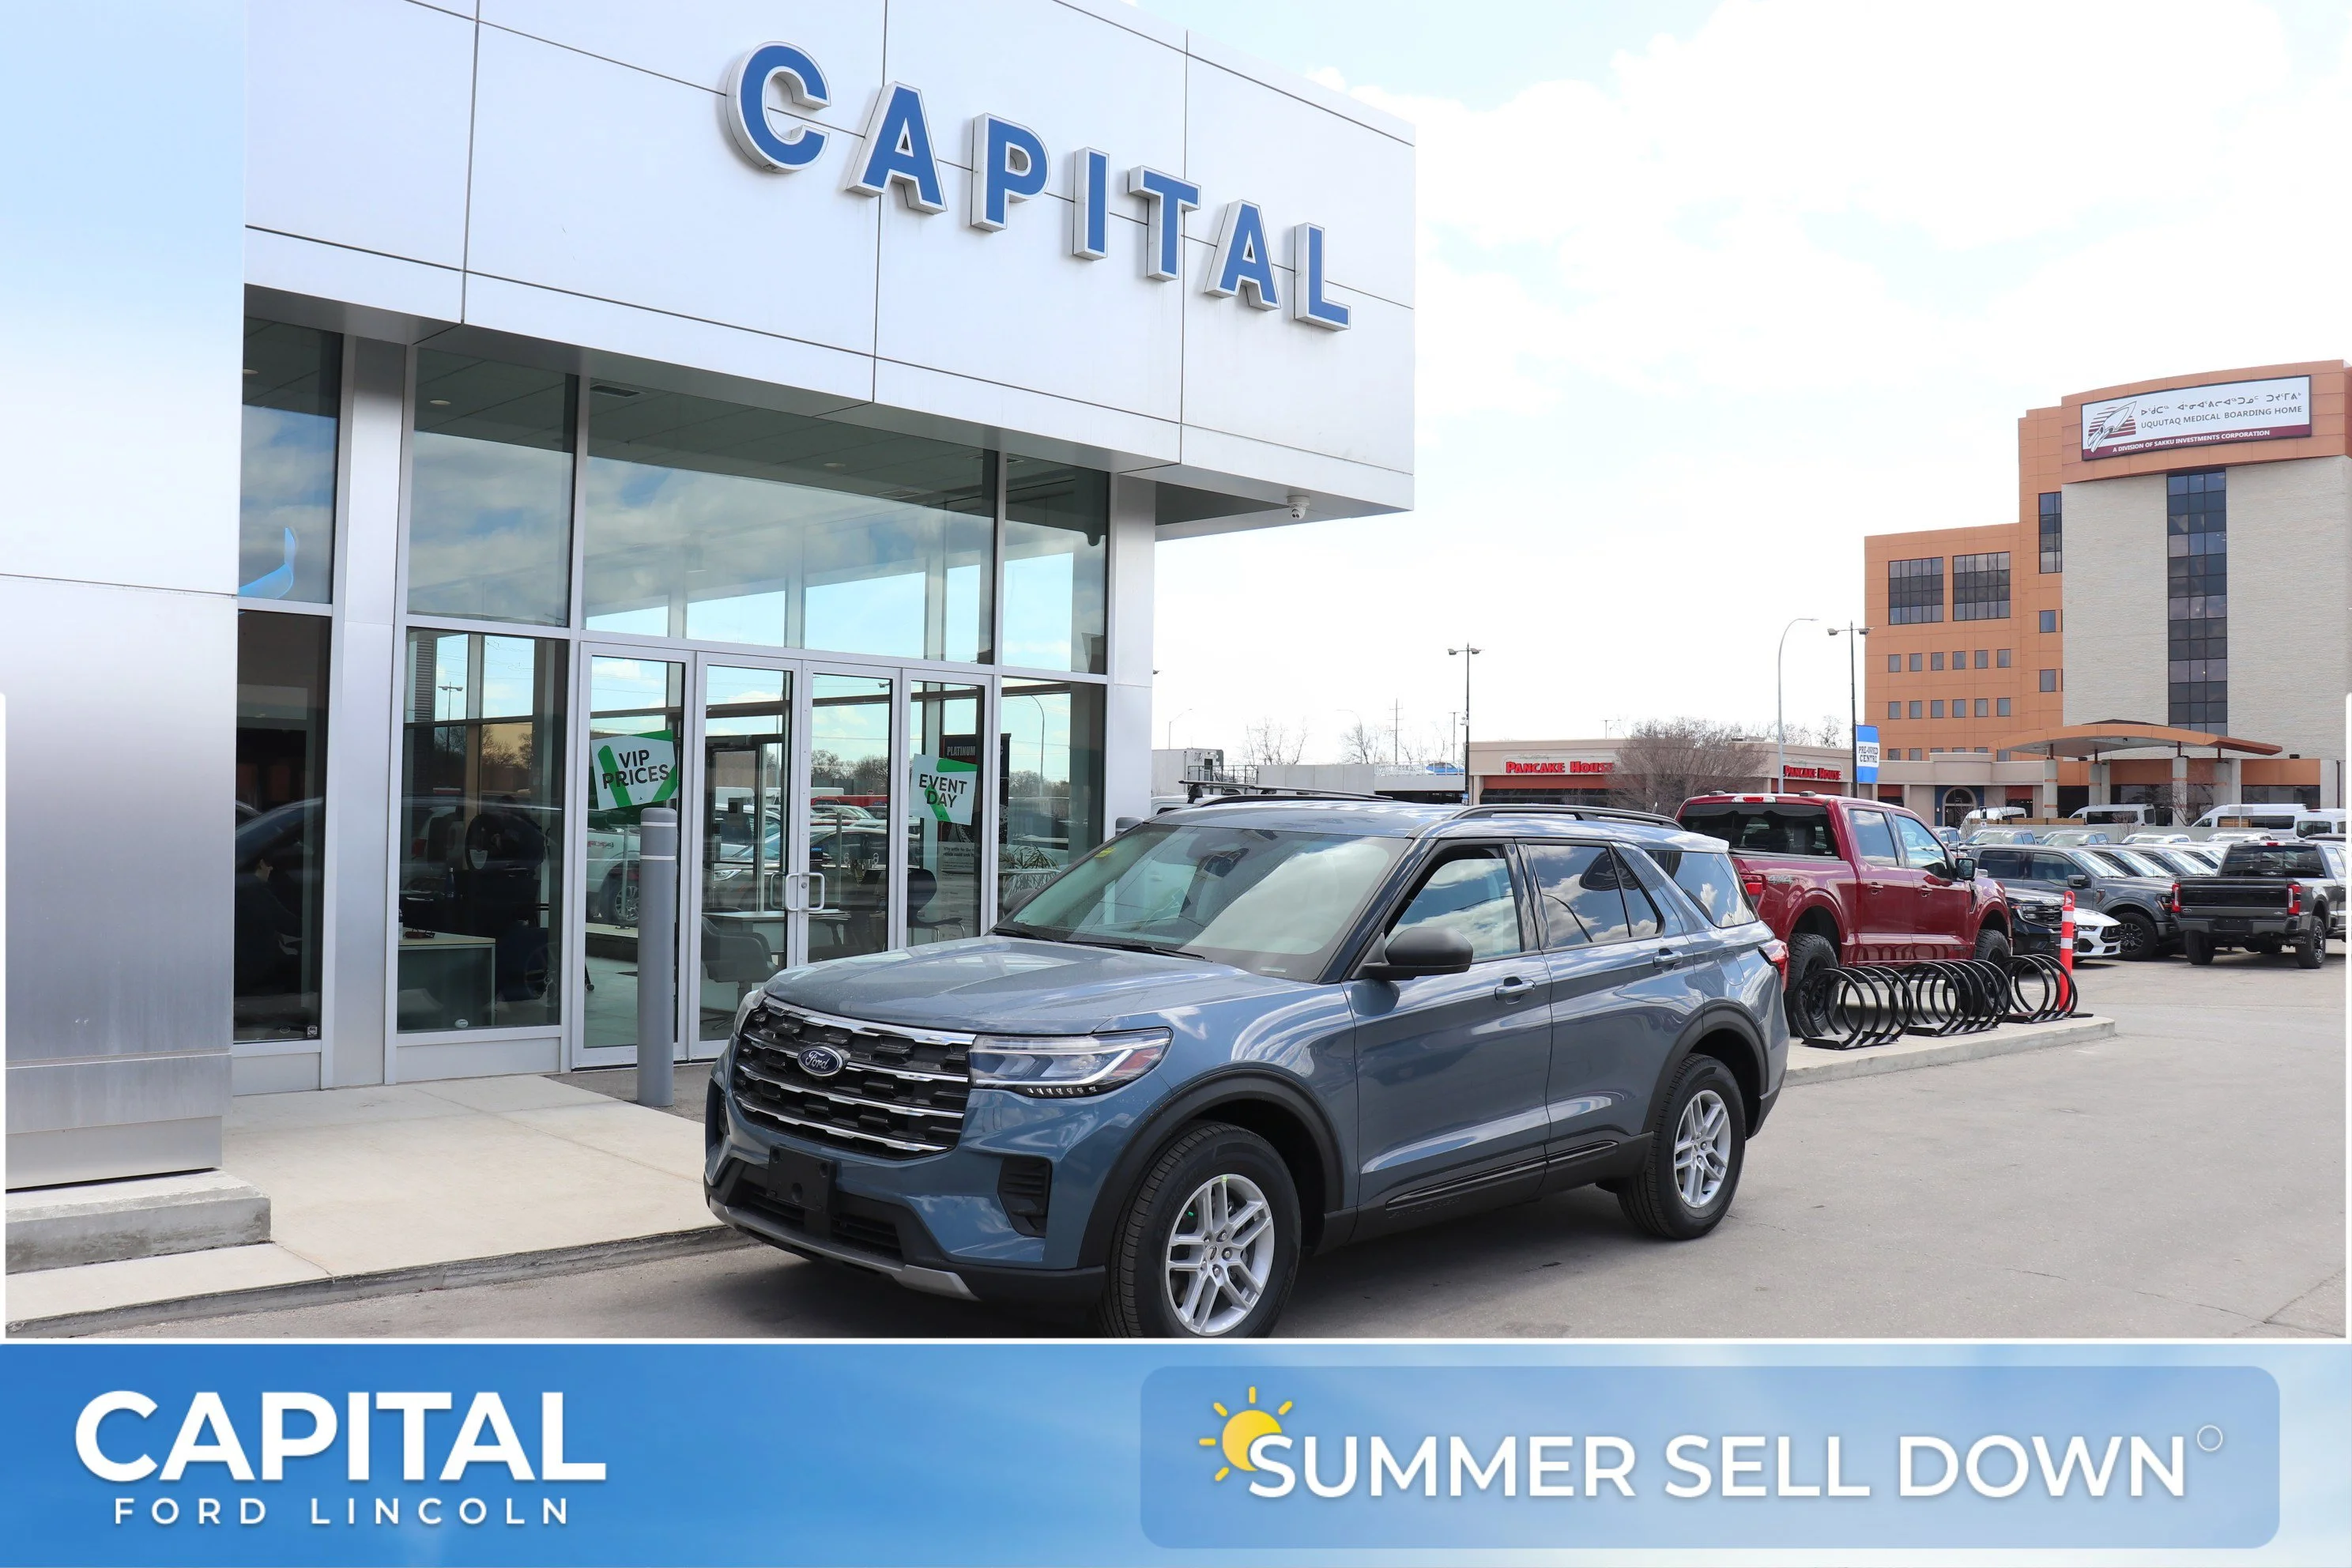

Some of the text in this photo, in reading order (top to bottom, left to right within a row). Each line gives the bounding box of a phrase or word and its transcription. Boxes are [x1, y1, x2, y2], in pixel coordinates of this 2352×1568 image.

[726, 41, 1351, 331] CAPITAL
[2141, 405, 2302, 429] UQUUTAQ MEDICAL BOARDING HOME
[2118, 443, 2143, 452] DIVISION
[2175, 434, 2220, 444] INVESTMENTS
[2221, 430, 2271, 439] CORPORATION
[619, 749, 650, 768] VIP
[947, 745, 976, 756] PLATINUM
[1860, 755, 1878, 763] CENTRE
[602, 763, 670, 790] PRICES
[1506, 761, 1566, 774] PANCAKE
[919, 774, 967, 794] EVENT
[926, 790, 957, 808] DAY
[805, 1050, 831, 1069] Ford
